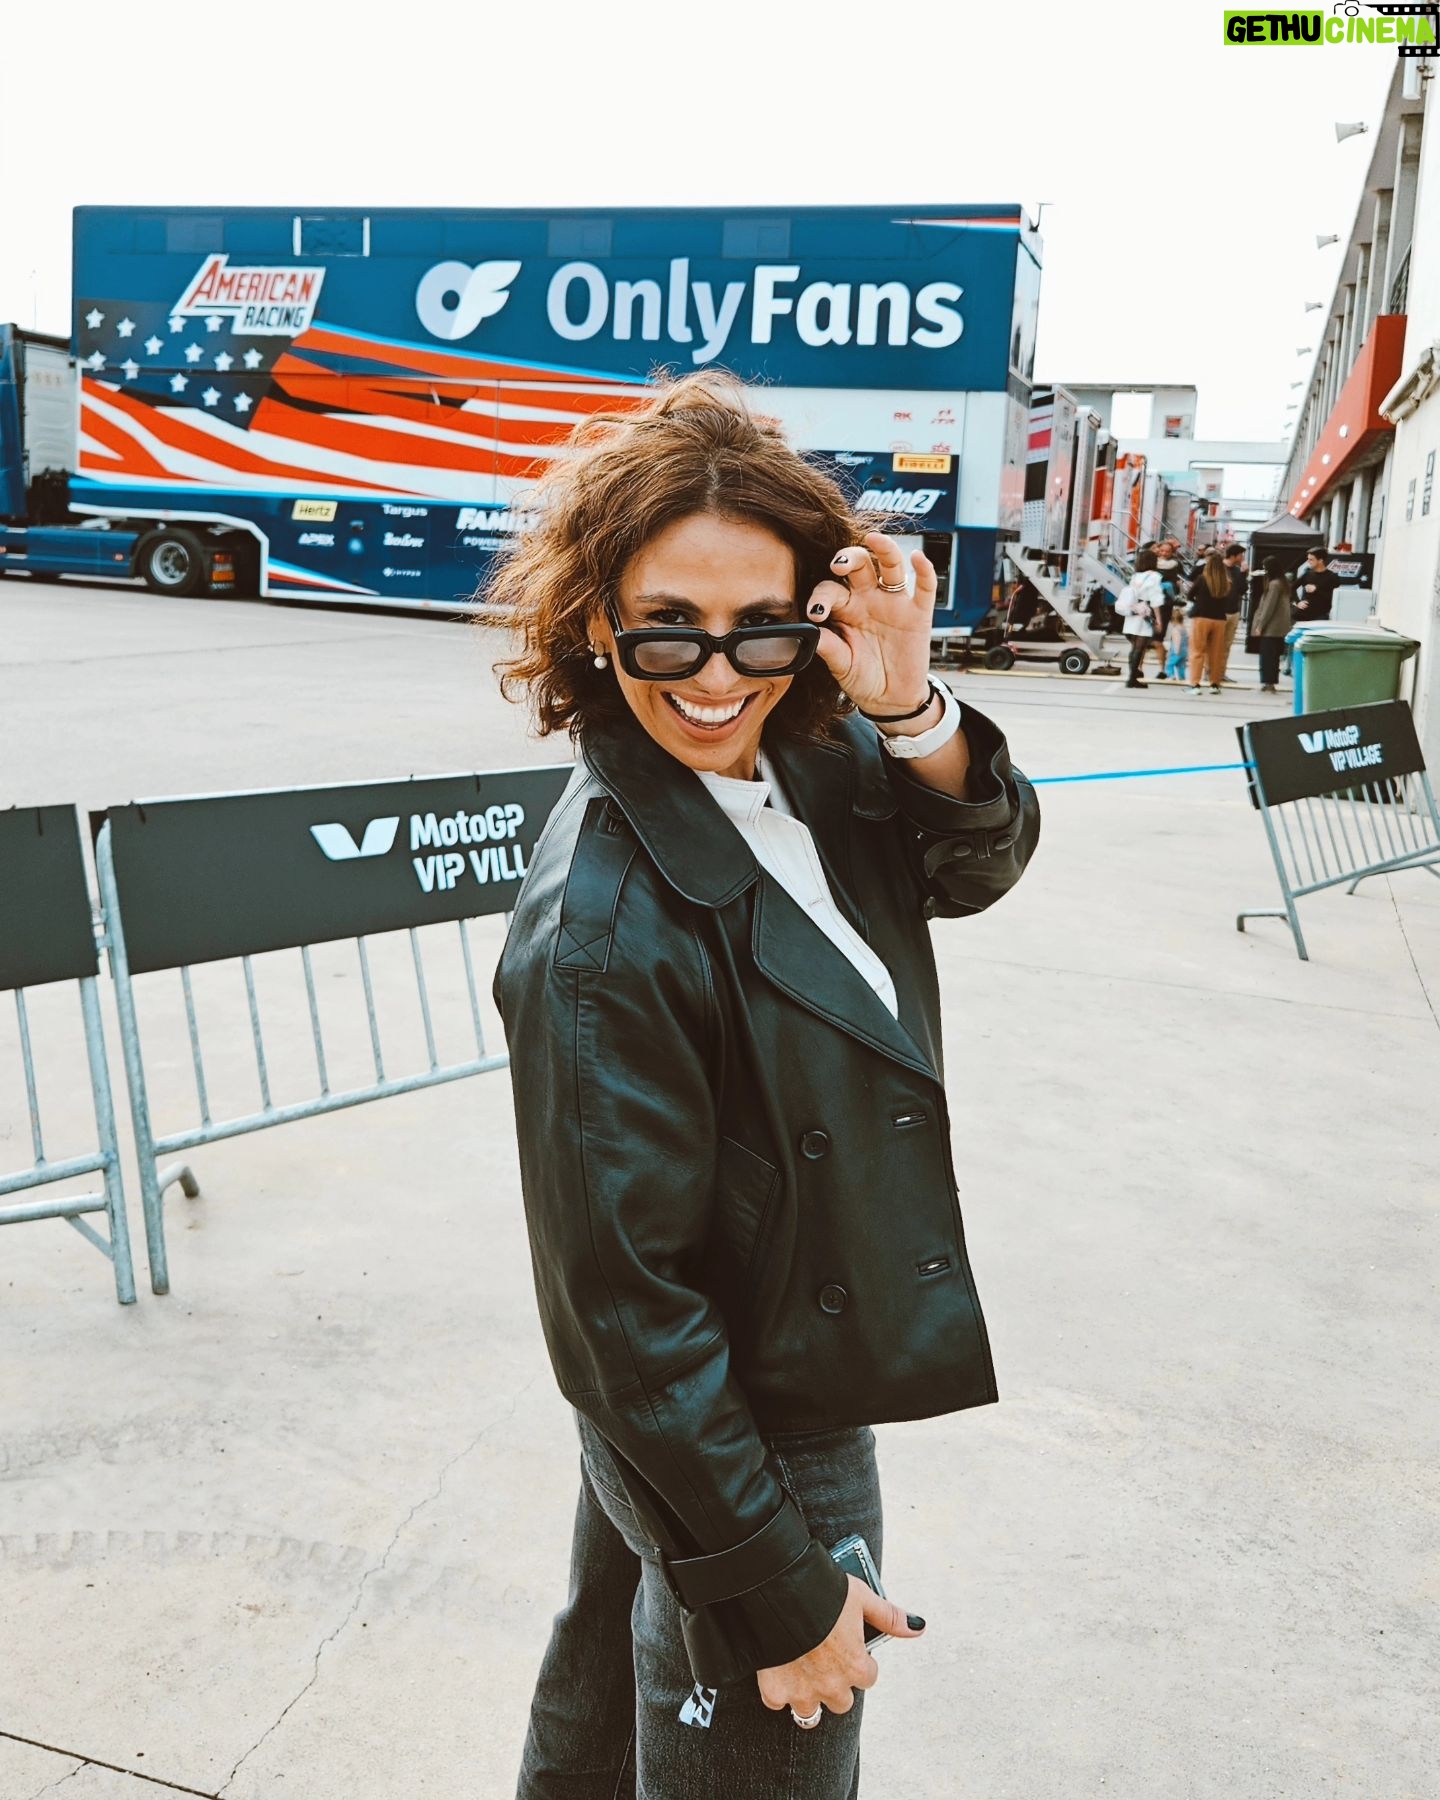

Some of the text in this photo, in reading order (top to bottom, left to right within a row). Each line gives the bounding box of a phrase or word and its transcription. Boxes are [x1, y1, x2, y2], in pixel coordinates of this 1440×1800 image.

[185, 260, 317, 309] AMERICAN
[243, 305, 308, 328] RACING
[546, 257, 965, 365] OnlyFans
[898, 456, 945, 470] PIRELLI
[299, 504, 332, 517] Hertz
[382, 503, 428, 518] Targus
[1323, 724, 1360, 750] MotoGP
[1328, 742, 1383, 773] VIP VILLAGE
[409, 803, 525, 851] MotoGP
[412, 843, 531, 894] VIP VILL
